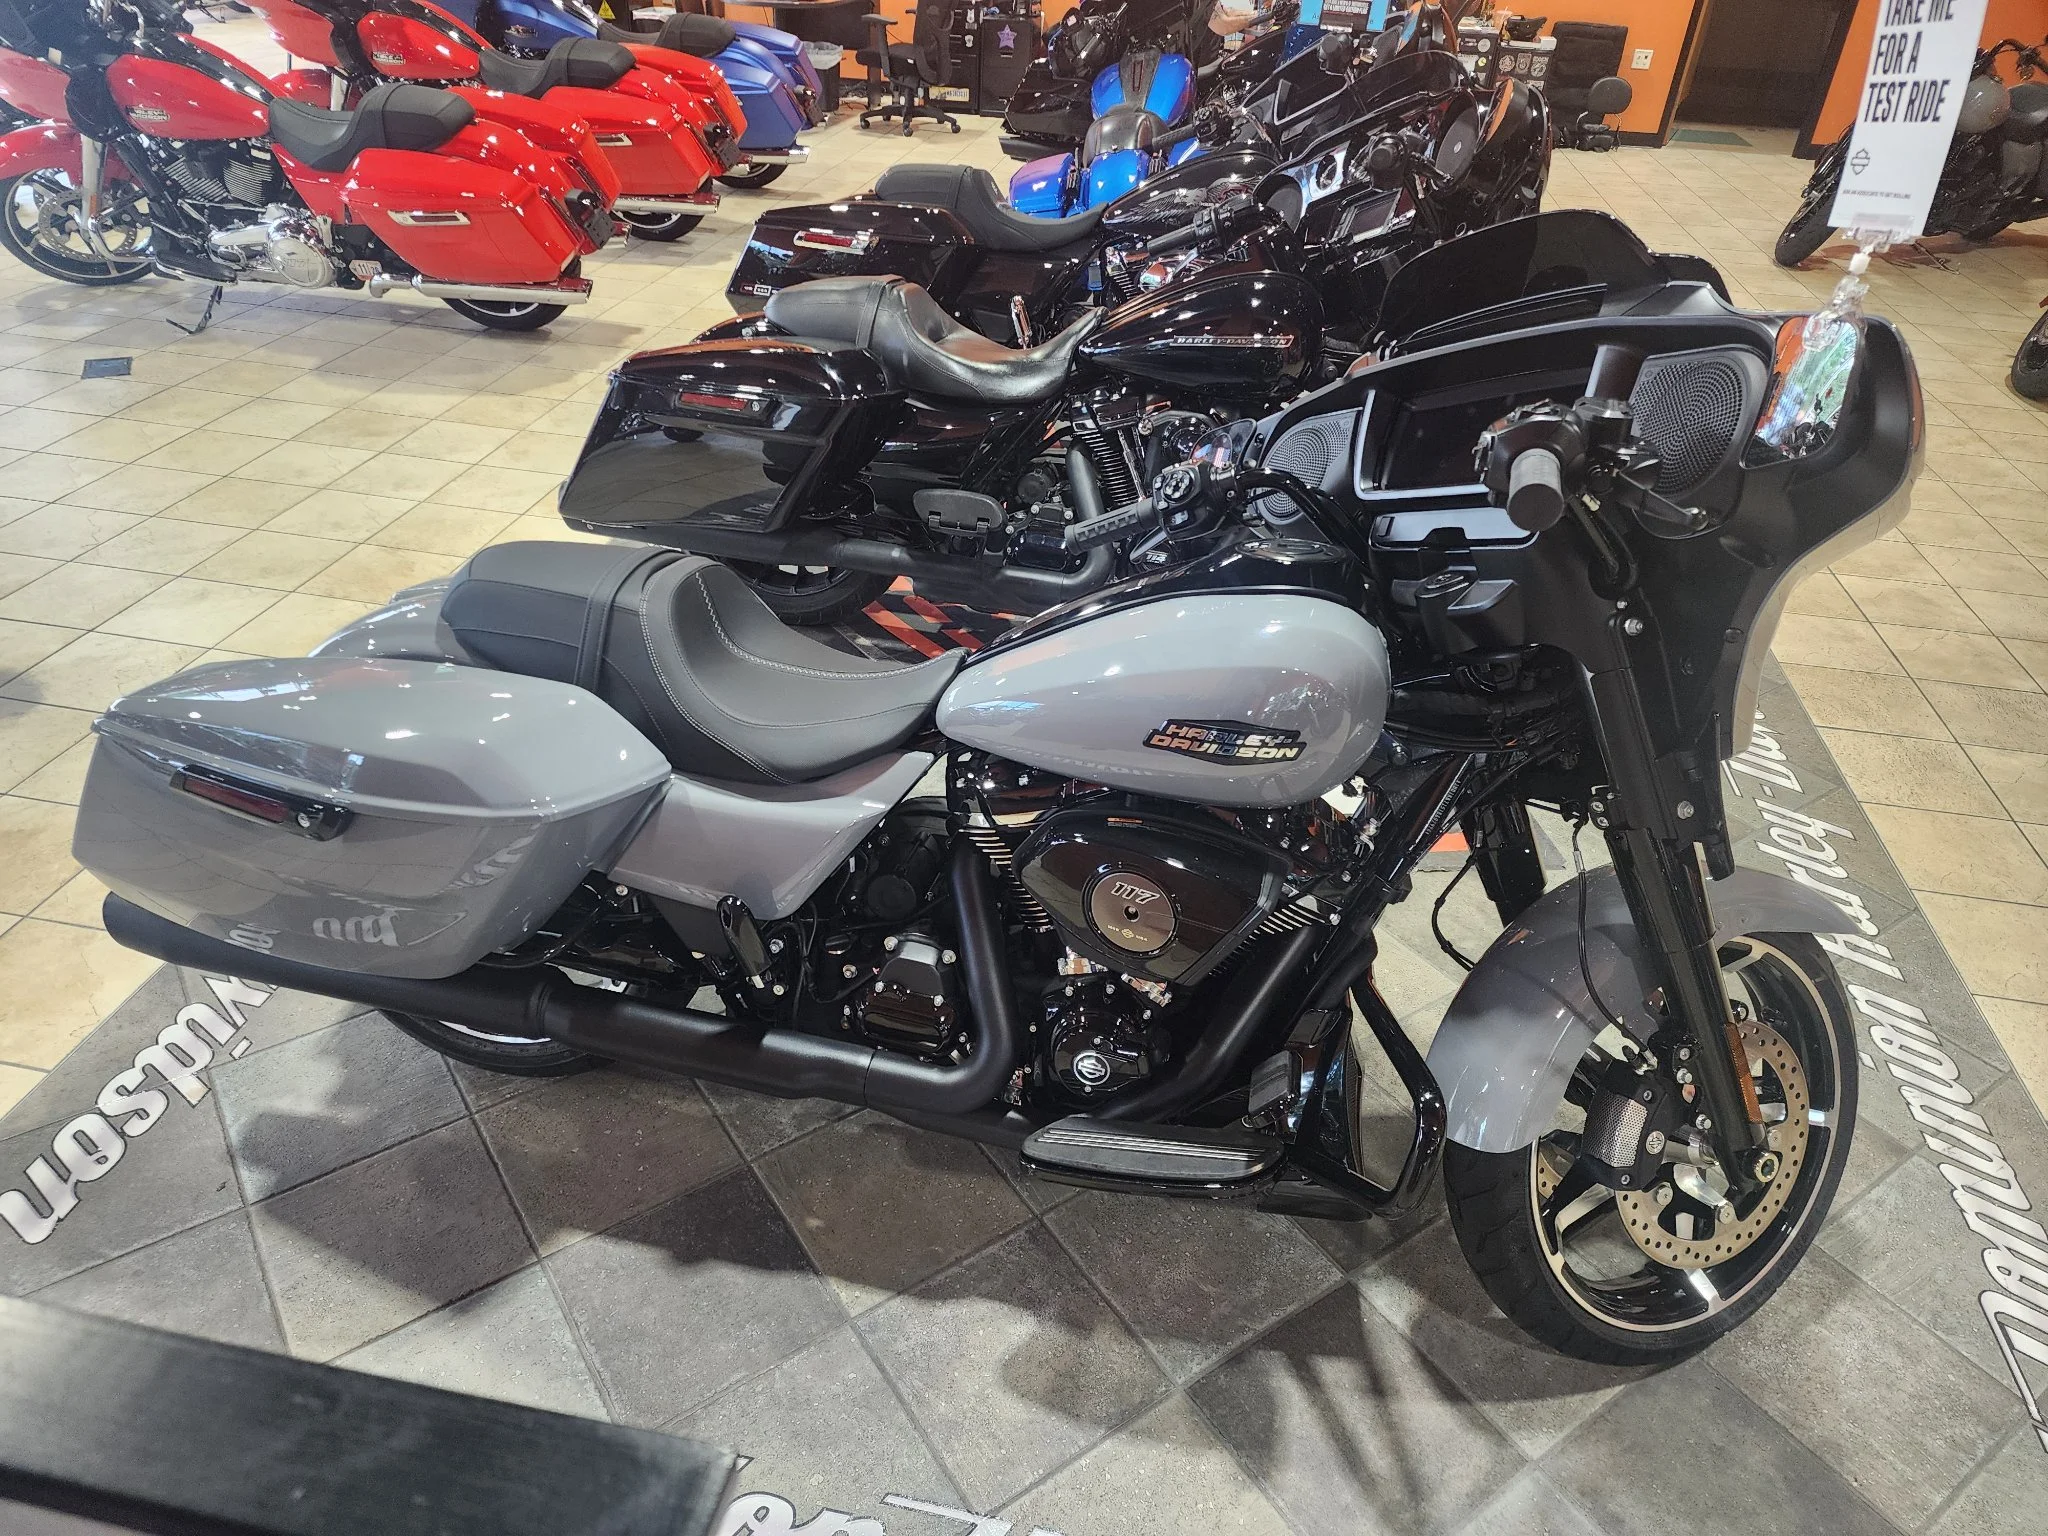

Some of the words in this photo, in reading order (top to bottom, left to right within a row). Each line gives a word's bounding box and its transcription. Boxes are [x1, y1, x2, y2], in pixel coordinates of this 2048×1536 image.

[1872, 32, 1908, 75] FOR
[1906, 31, 1922, 74] A
[1864, 81, 1909, 123] TEST
[1904, 80, 1951, 123] RIDE
[1149, 734, 1300, 759] DAVIDSON
[1166, 724, 1293, 746] HARLEY-
[1110, 881, 1161, 905] 117
